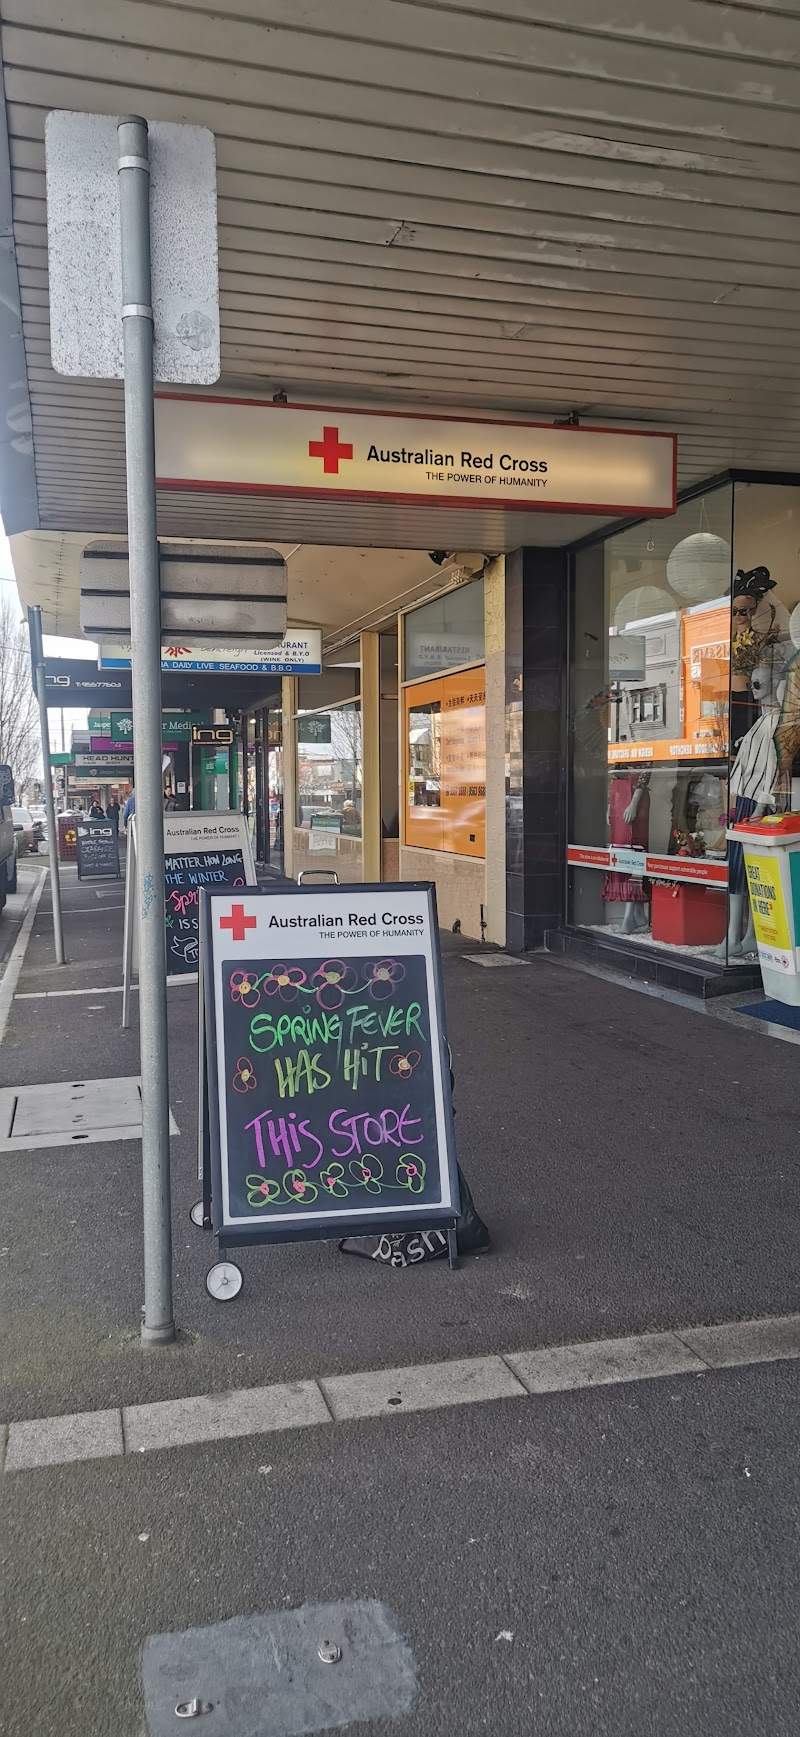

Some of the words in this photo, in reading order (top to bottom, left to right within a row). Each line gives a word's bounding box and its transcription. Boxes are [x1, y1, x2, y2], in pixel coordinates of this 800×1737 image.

[367, 445, 454, 467] Australian
[461, 450, 493, 470] Red
[499, 453, 548, 474] Cross
[426, 472, 444, 481] THE
[447, 473, 483, 484] POWER
[485, 476, 498, 485] OF
[499, 477, 547, 488] HUMANITY
[219, 663, 259, 672] SEAFOOD
[271, 664, 292, 672] B.B.Q
[193, 726, 233, 744] ing
[90, 827, 113, 836] ing
[219, 826, 240, 834] Cross
[165, 856, 205, 872] MATTER
[204, 855, 220, 868] HOW
[165, 874, 185, 885] THE
[189, 869, 229, 885] WINTER
[268, 915, 343, 931] Australian
[348, 914, 377, 928] Red
[382, 912, 424, 927] Cross
[319, 931, 334, 939] THE
[337, 931, 363, 939] POWER
[368, 930, 379, 938] OF
[383, 928, 424, 938] HUMANITY
[274, 1050, 332, 1098] HAS
[328, 1104, 424, 1157] STORE
